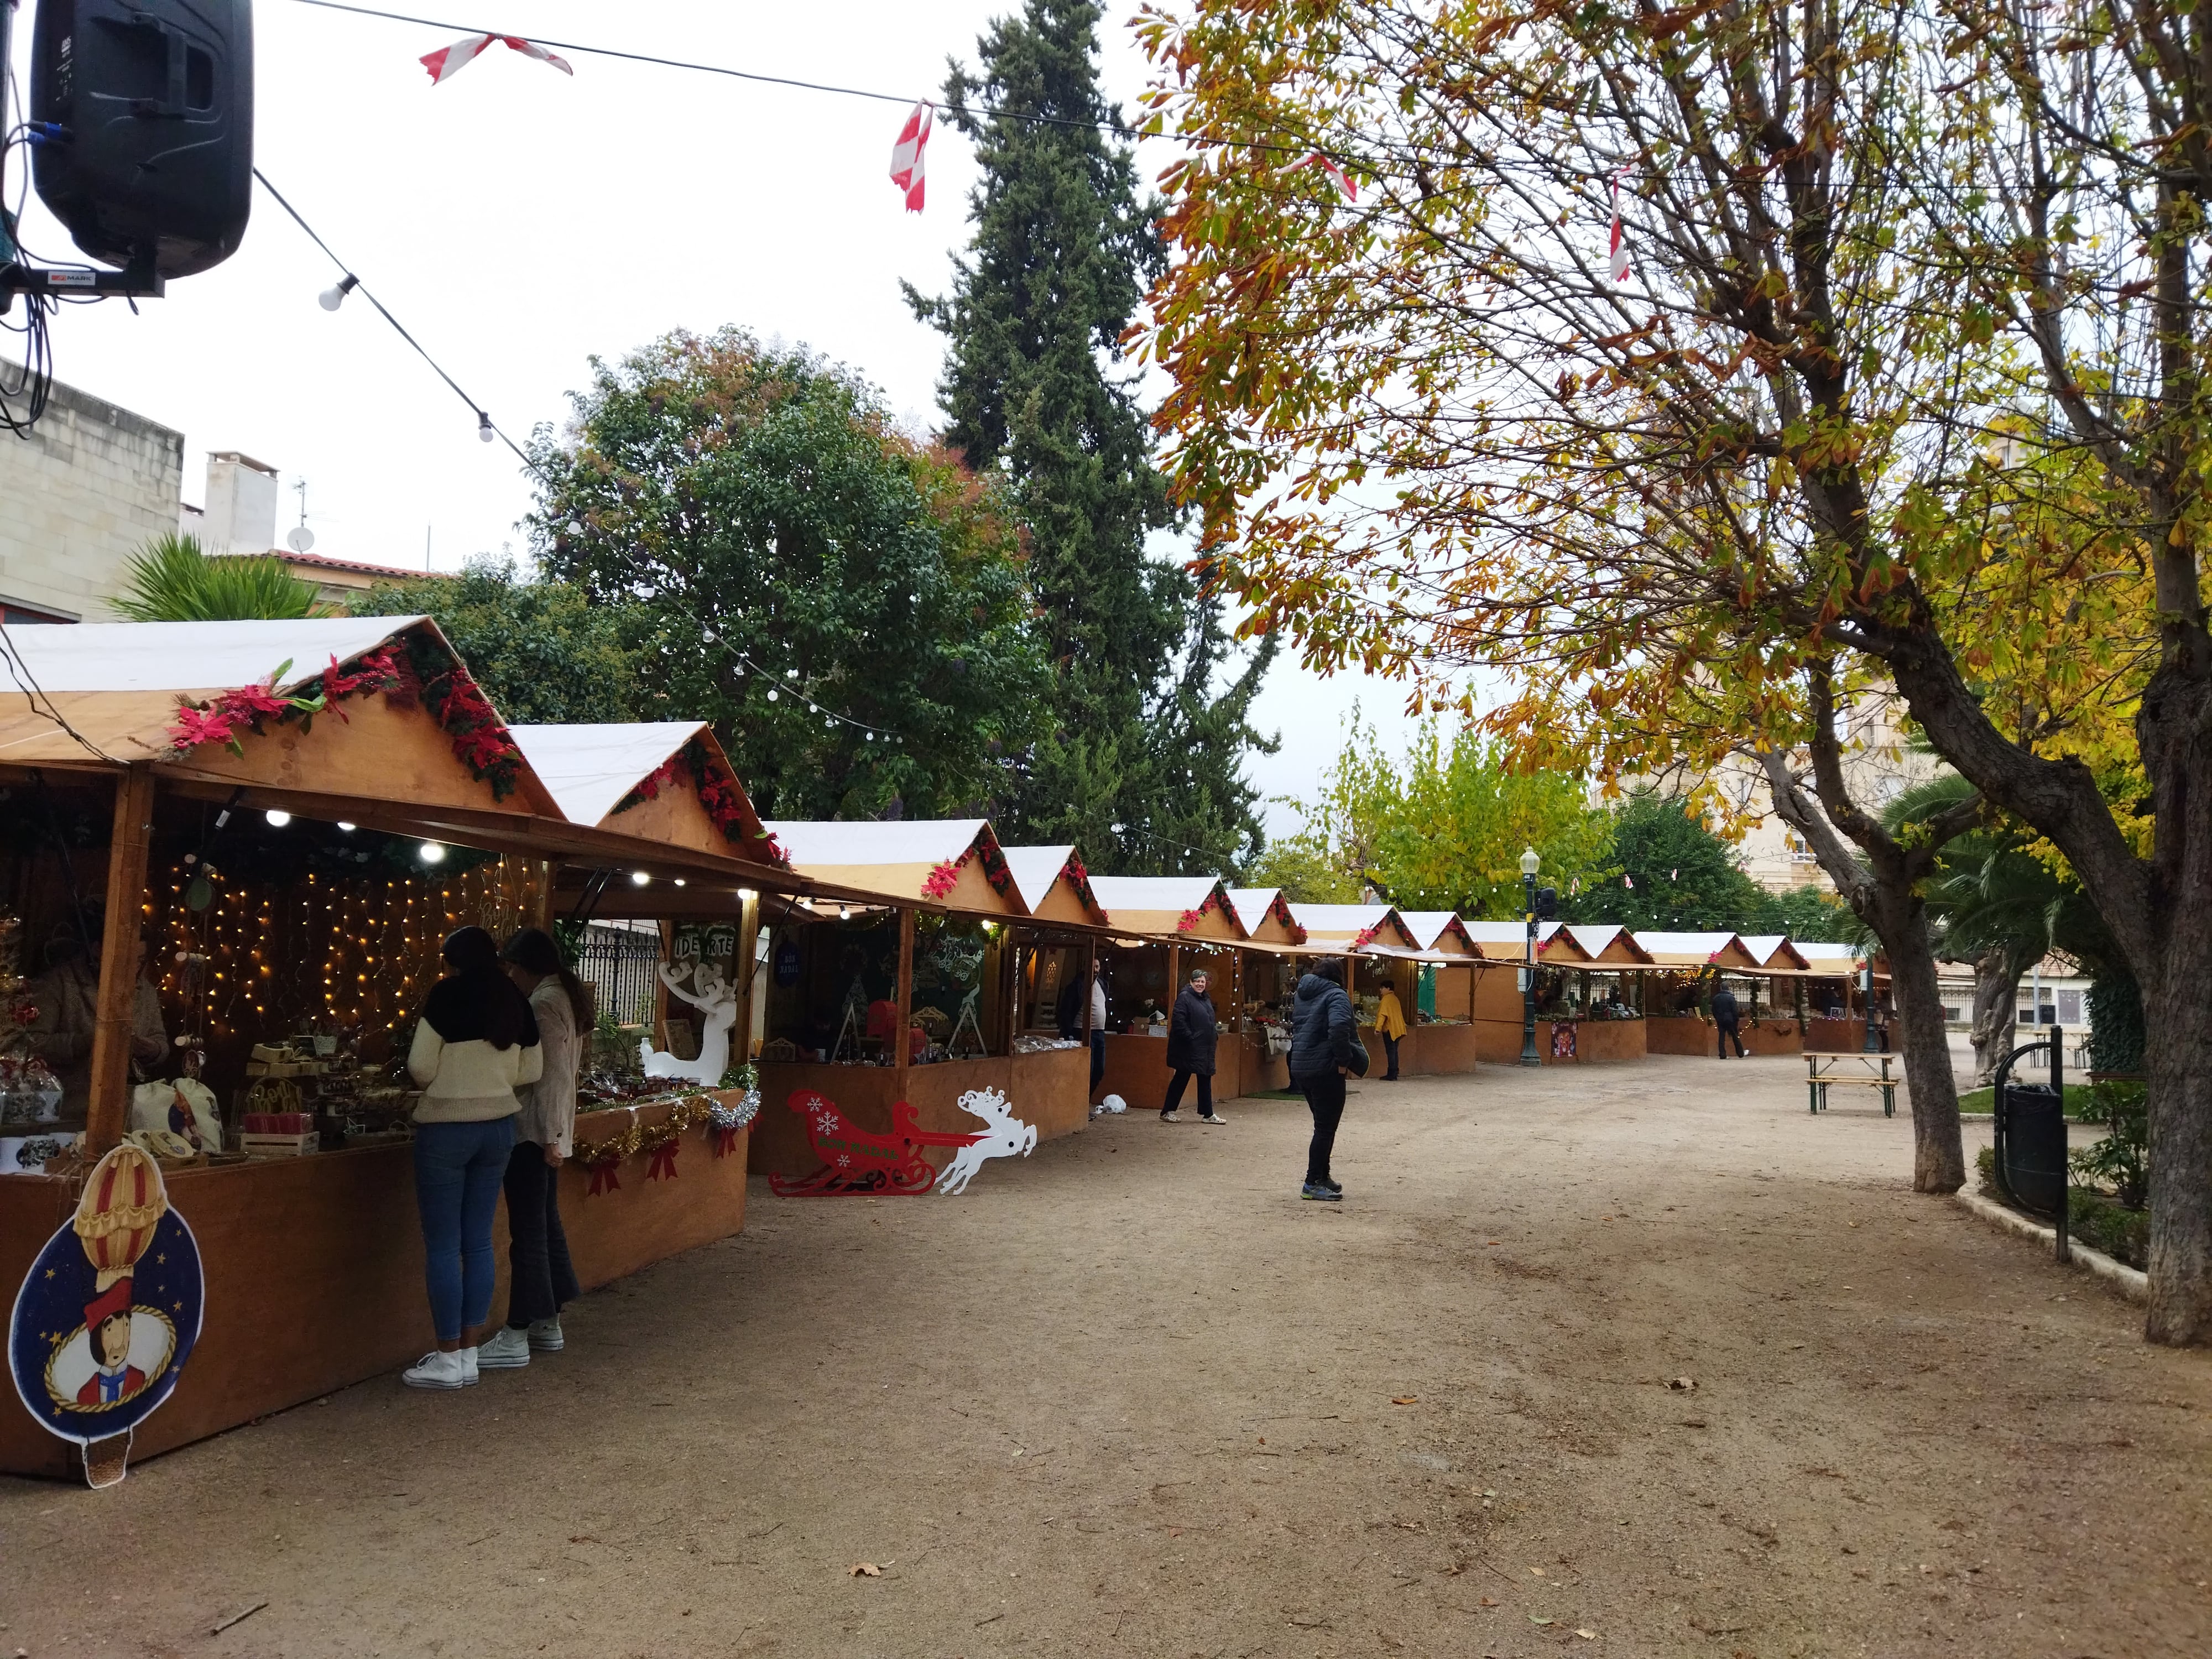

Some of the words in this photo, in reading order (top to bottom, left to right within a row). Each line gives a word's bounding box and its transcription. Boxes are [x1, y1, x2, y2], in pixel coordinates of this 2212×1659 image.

[675, 937, 734, 957] IDERTE
[818, 1136, 847, 1151] BON
[851, 1141, 899, 1160] NADAL
